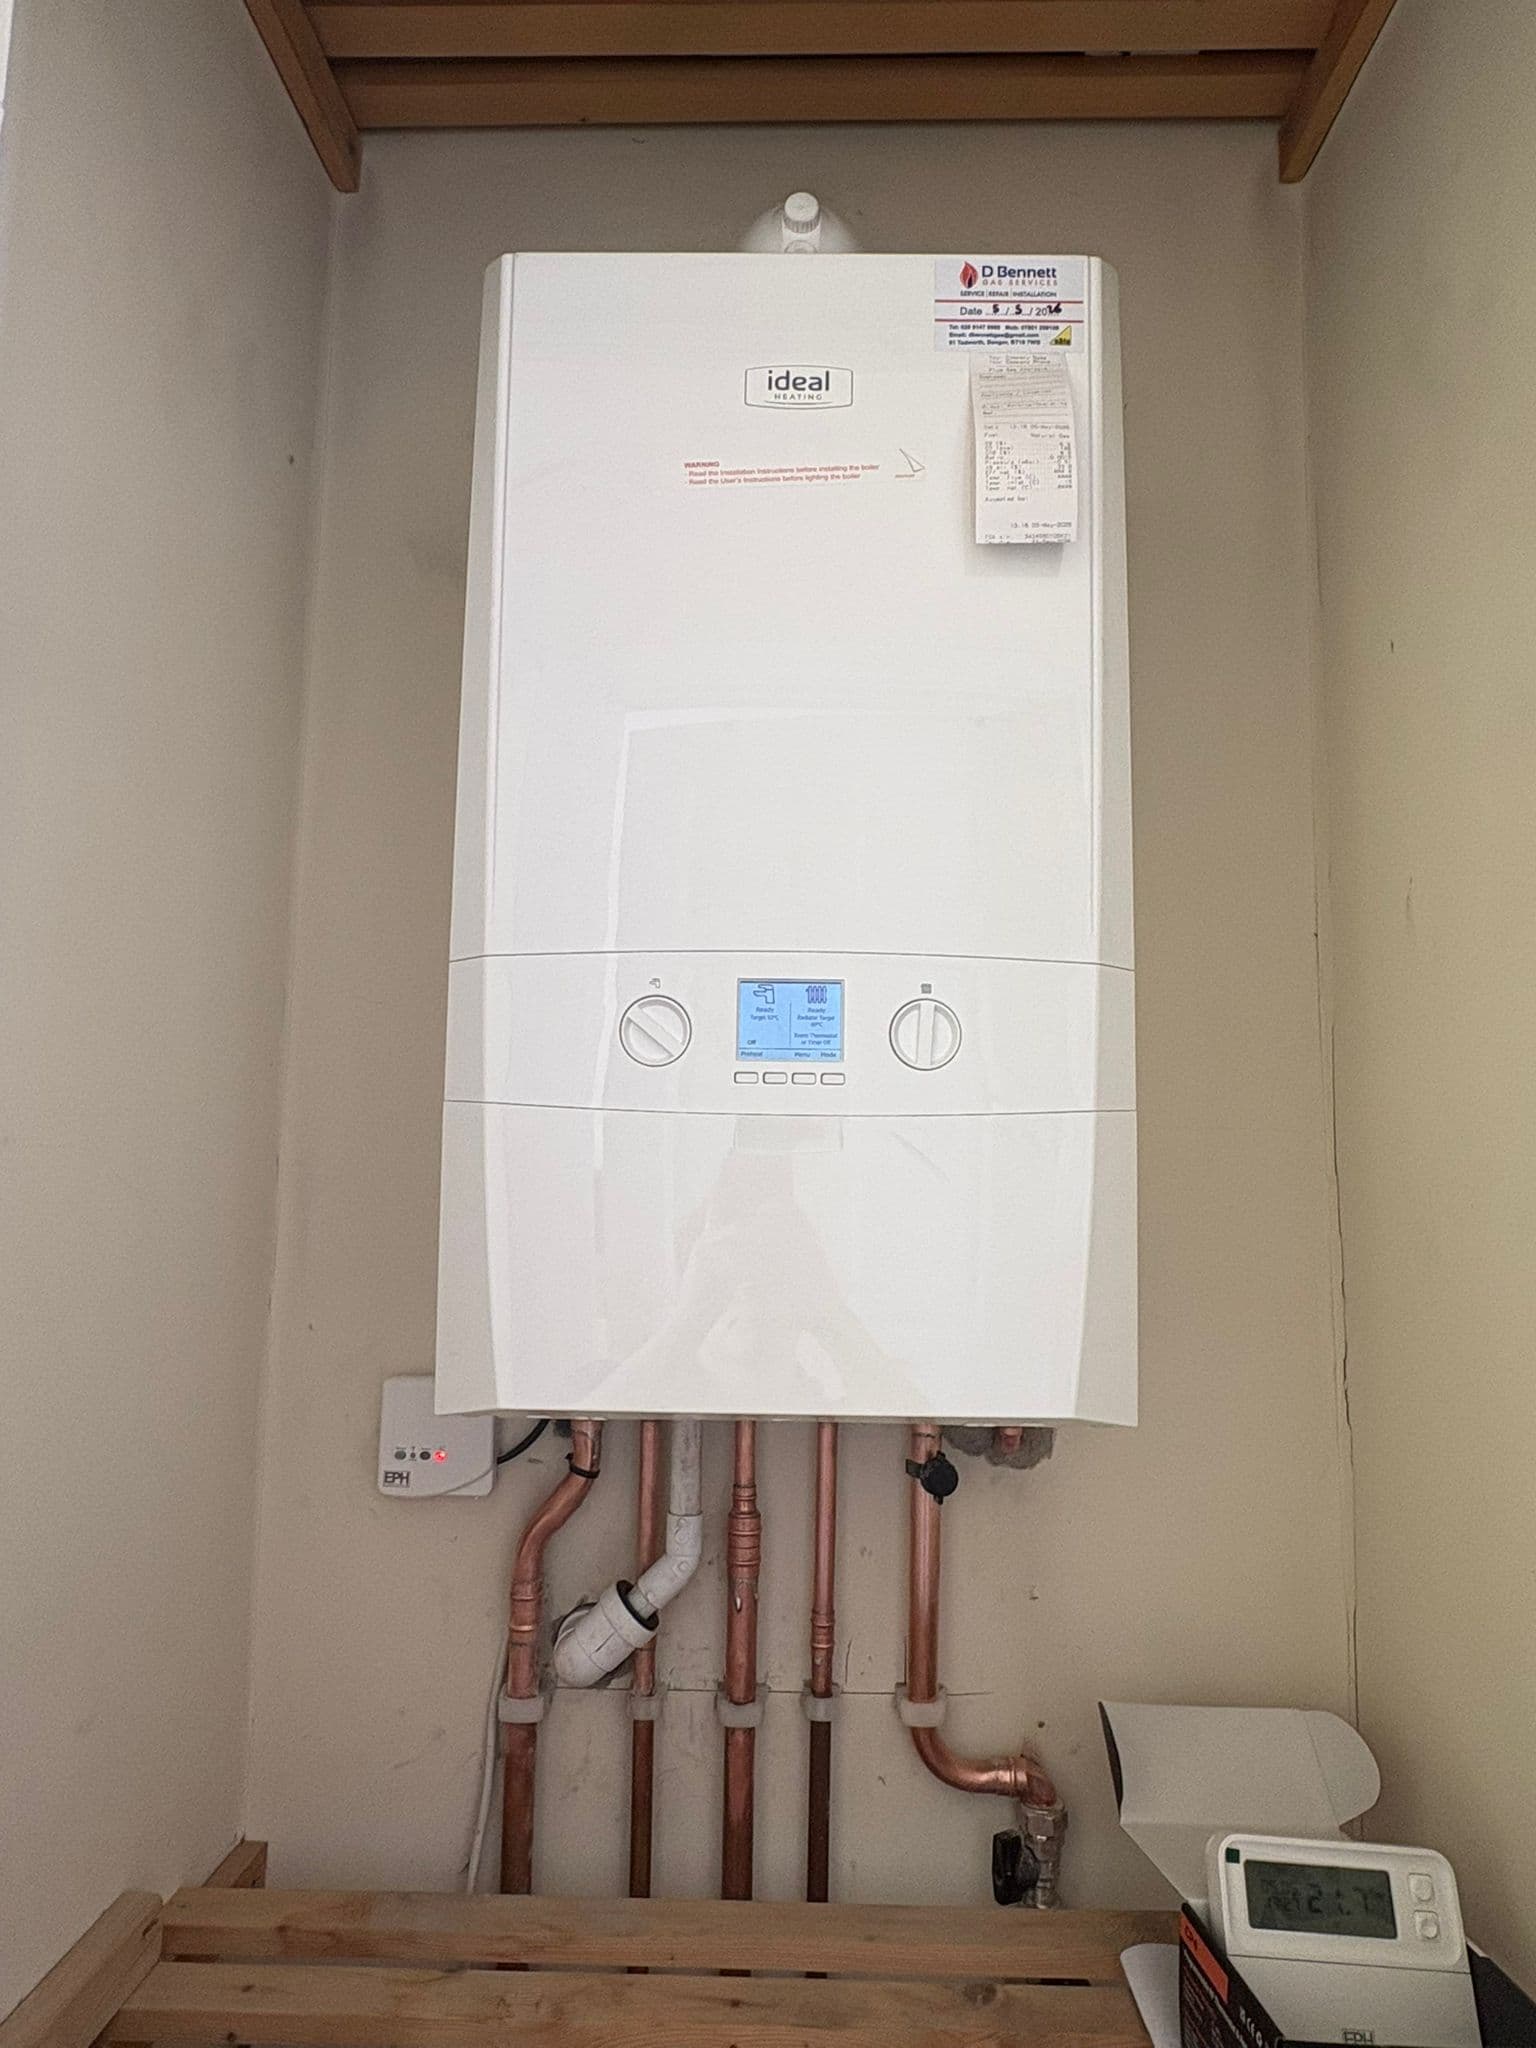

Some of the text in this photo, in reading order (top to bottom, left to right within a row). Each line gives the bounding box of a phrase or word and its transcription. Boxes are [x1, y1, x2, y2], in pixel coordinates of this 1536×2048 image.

[982, 266, 1057, 278] D Bennett
[960, 306, 982, 316] Date
[767, 369, 830, 392] ideal
[774, 392, 822, 401] HEATING
[384, 1471, 410, 1486] EPH
